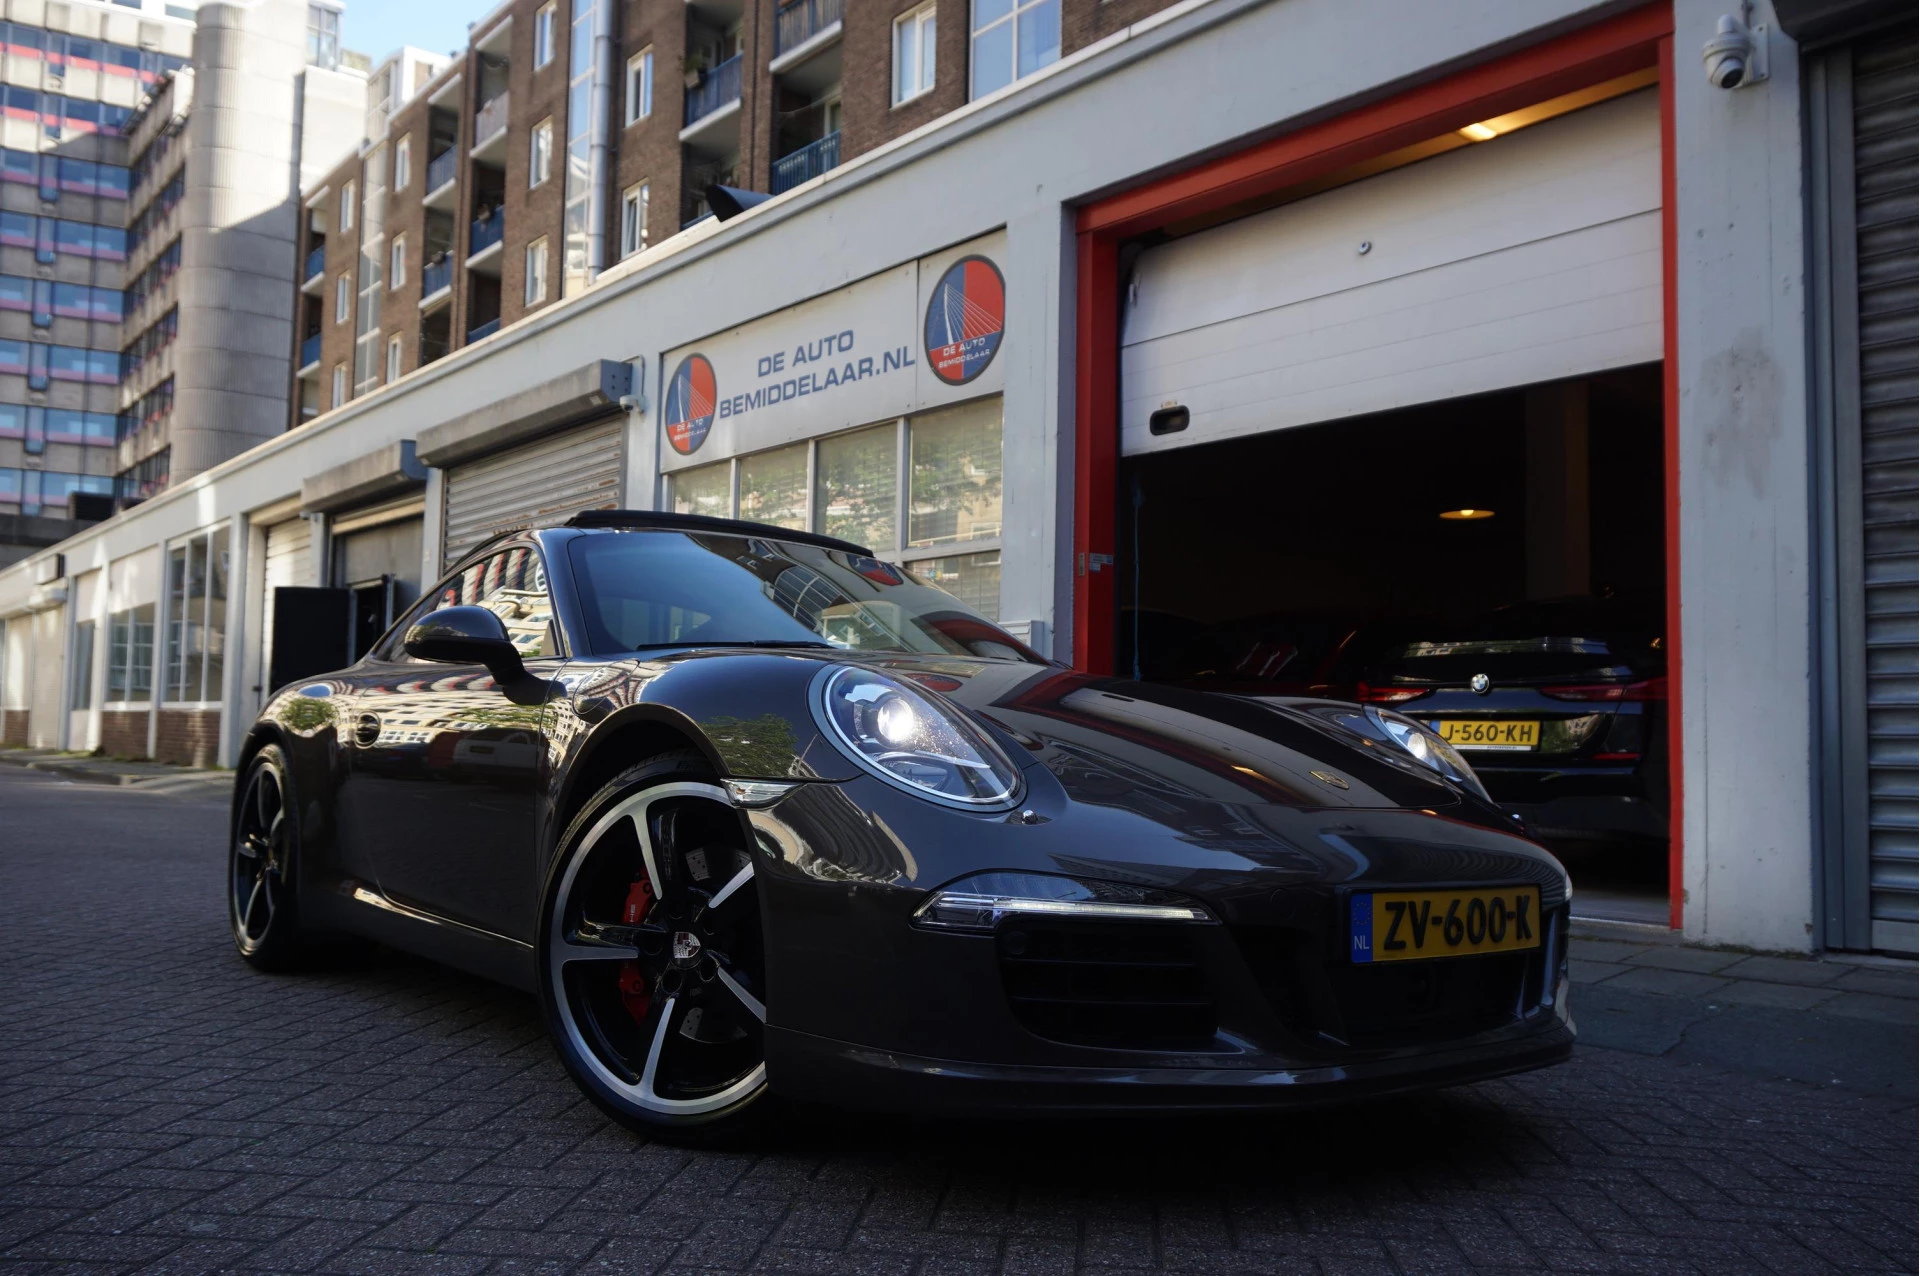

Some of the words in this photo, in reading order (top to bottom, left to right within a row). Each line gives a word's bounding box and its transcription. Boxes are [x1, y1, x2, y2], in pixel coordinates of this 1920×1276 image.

[758, 351, 785, 377] DE
[792, 329, 854, 367] AUTO
[943, 345, 956, 357] DE
[959, 337, 986, 352] AUTO
[719, 346, 916, 419] BEMIDDELAAR.NL
[1444, 724, 1532, 742] J-560-KH
[1383, 895, 1533, 950] ZV-600-K
[1354, 935, 1370, 950] NL
